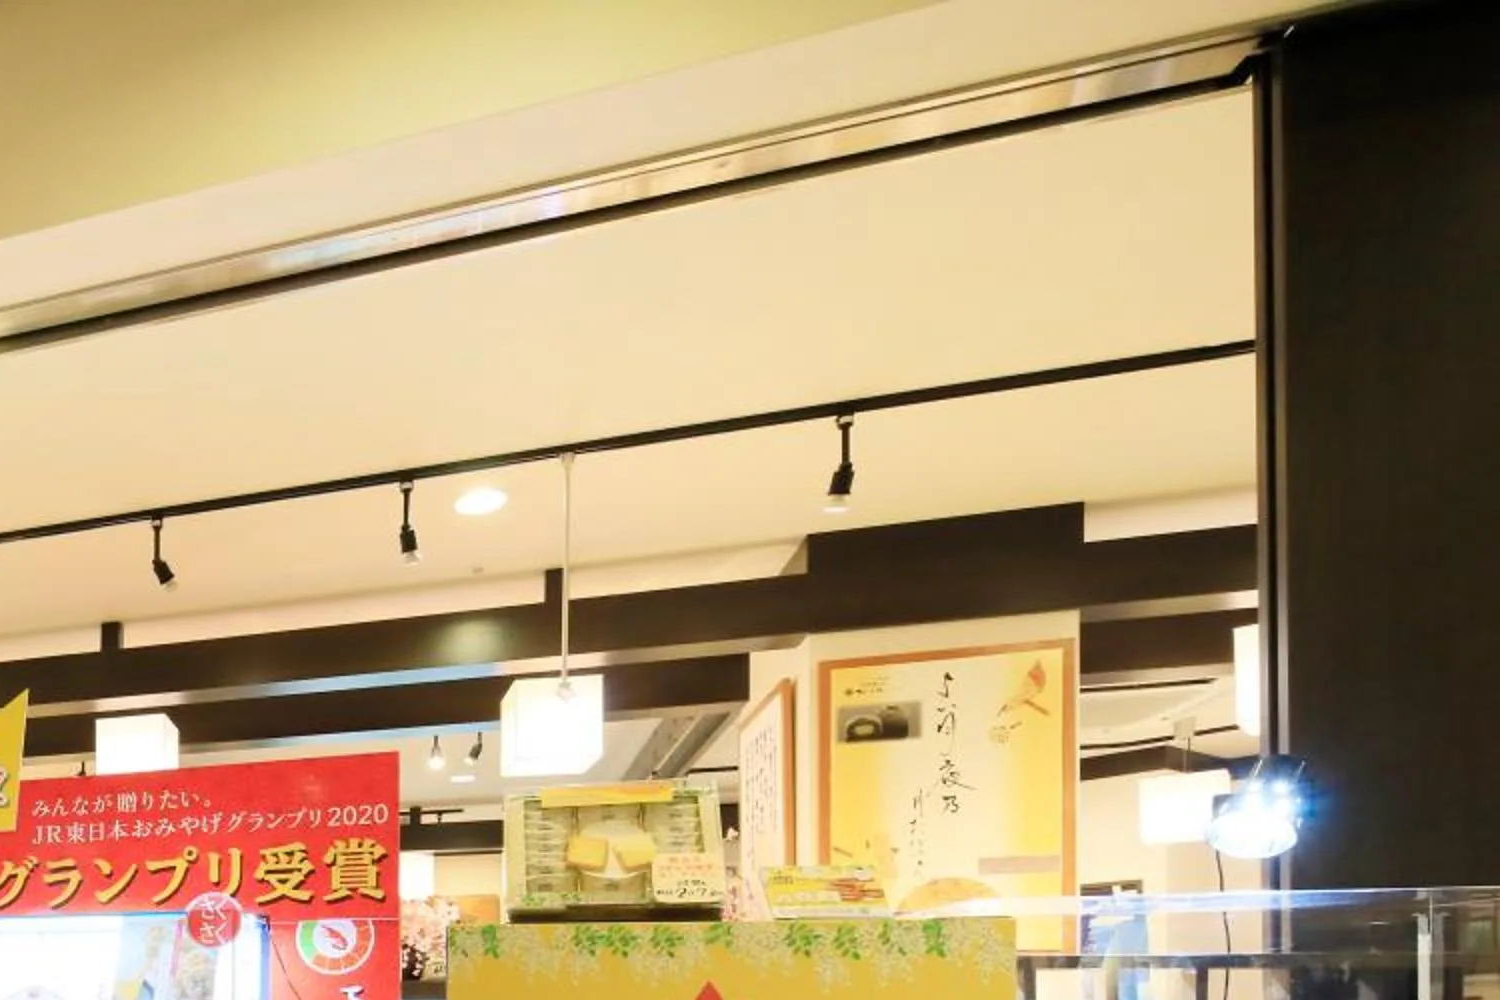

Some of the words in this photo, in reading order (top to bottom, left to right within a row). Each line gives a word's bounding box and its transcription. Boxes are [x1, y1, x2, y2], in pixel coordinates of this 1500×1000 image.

[32, 788, 213, 817] みんなが贈りたい。
